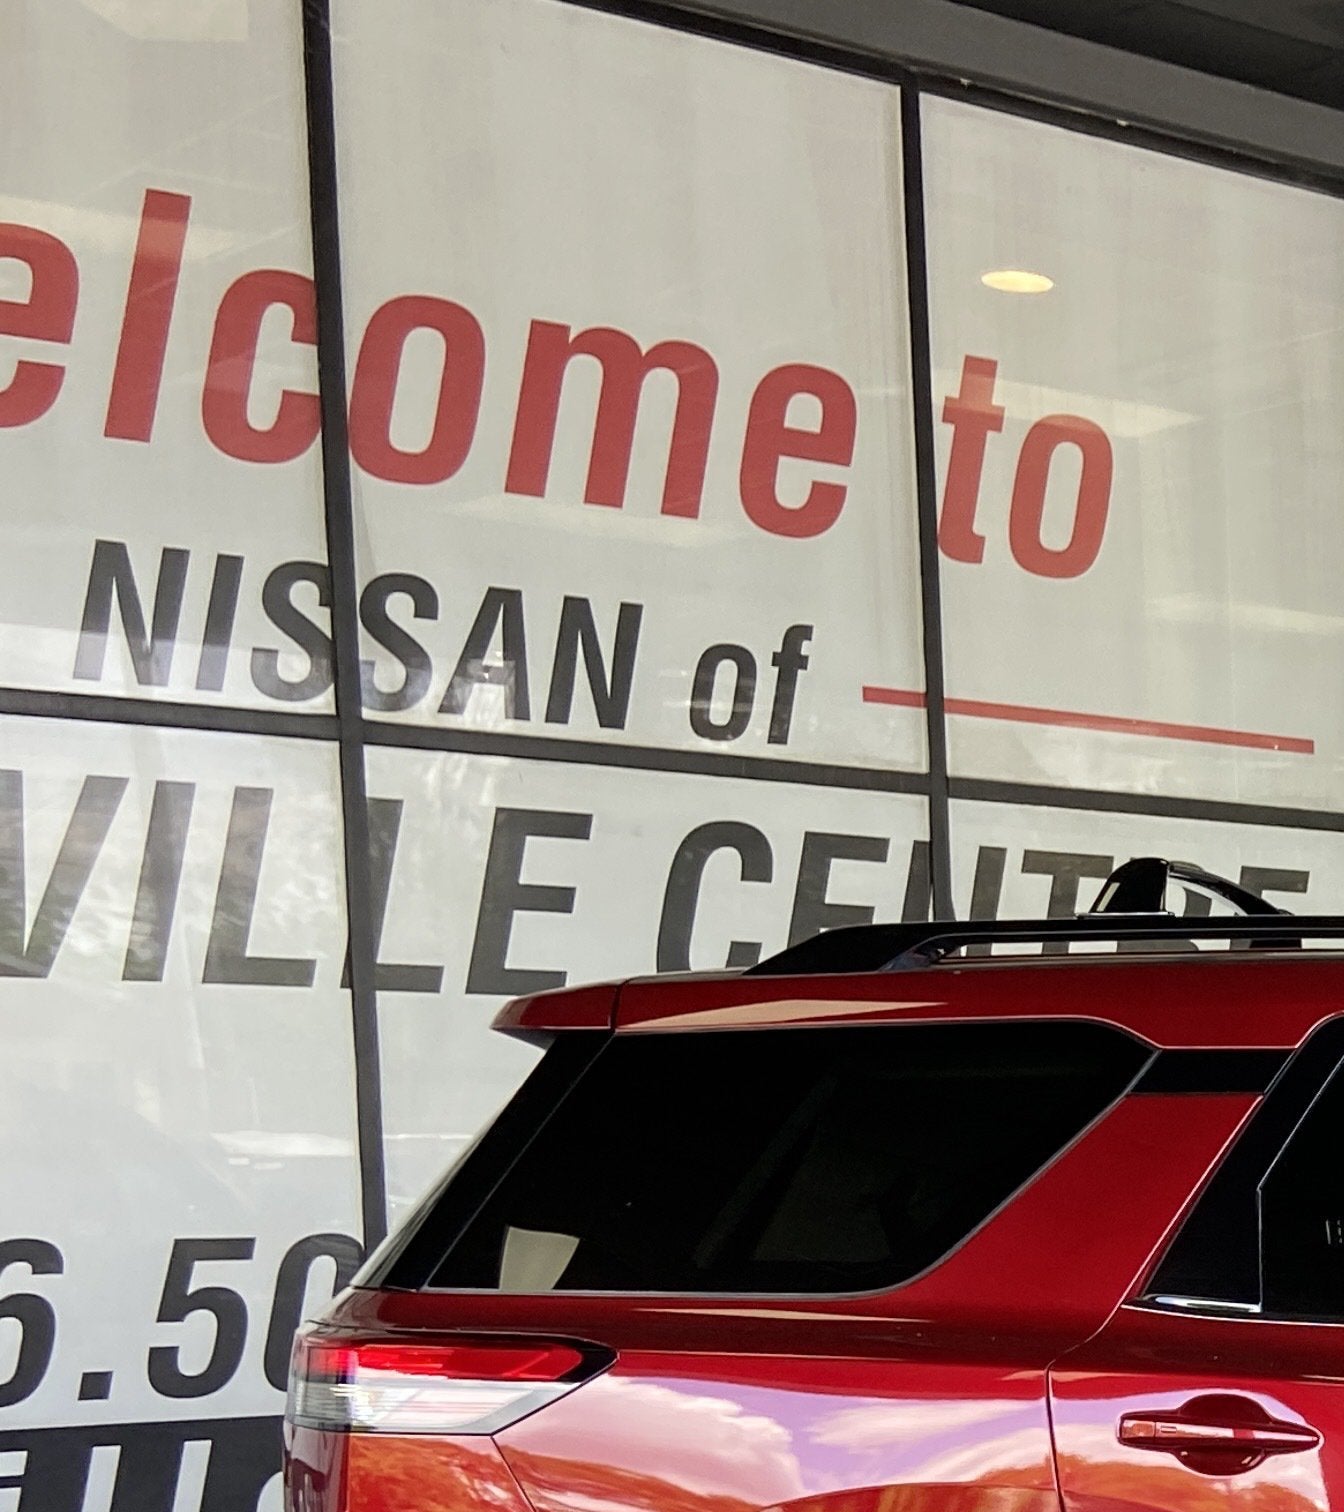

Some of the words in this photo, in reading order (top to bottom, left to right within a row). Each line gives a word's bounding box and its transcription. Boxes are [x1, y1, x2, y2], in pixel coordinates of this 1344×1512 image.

[937, 354, 1114, 579] to
[72, 539, 643, 730] NISSAN
[689, 624, 814, 745] of
[656, 820, 1310, 972] CENT
